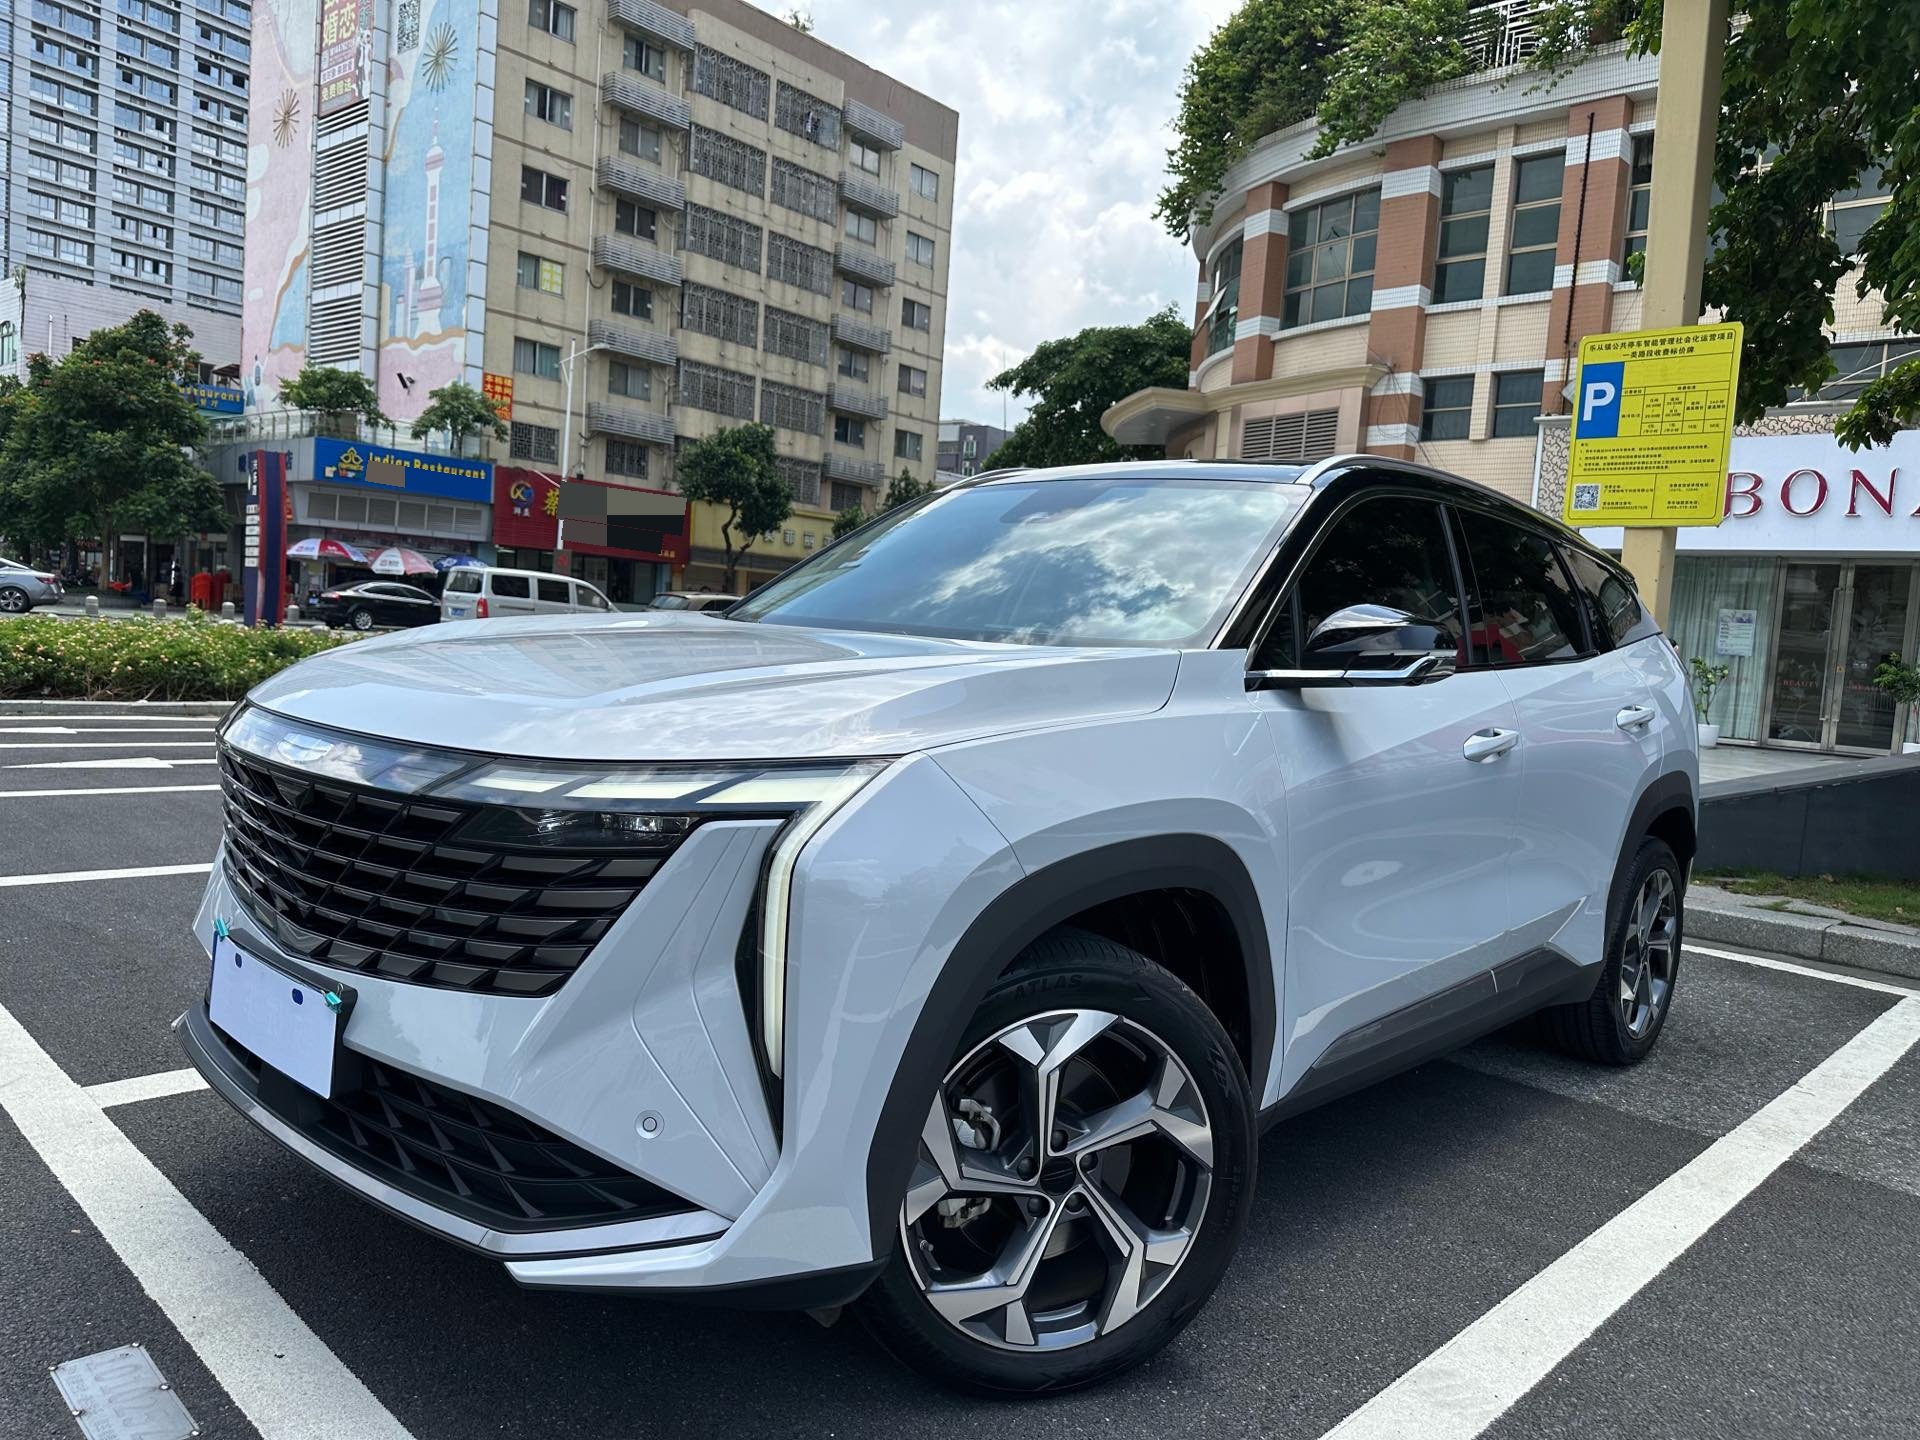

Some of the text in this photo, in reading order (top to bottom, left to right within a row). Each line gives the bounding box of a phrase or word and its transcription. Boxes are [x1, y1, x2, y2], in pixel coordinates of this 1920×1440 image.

[1583, 382, 1616, 421] P
[369, 452, 486, 480] Indian Restaurant
[1015, 974, 1084, 1001] ATLAS
